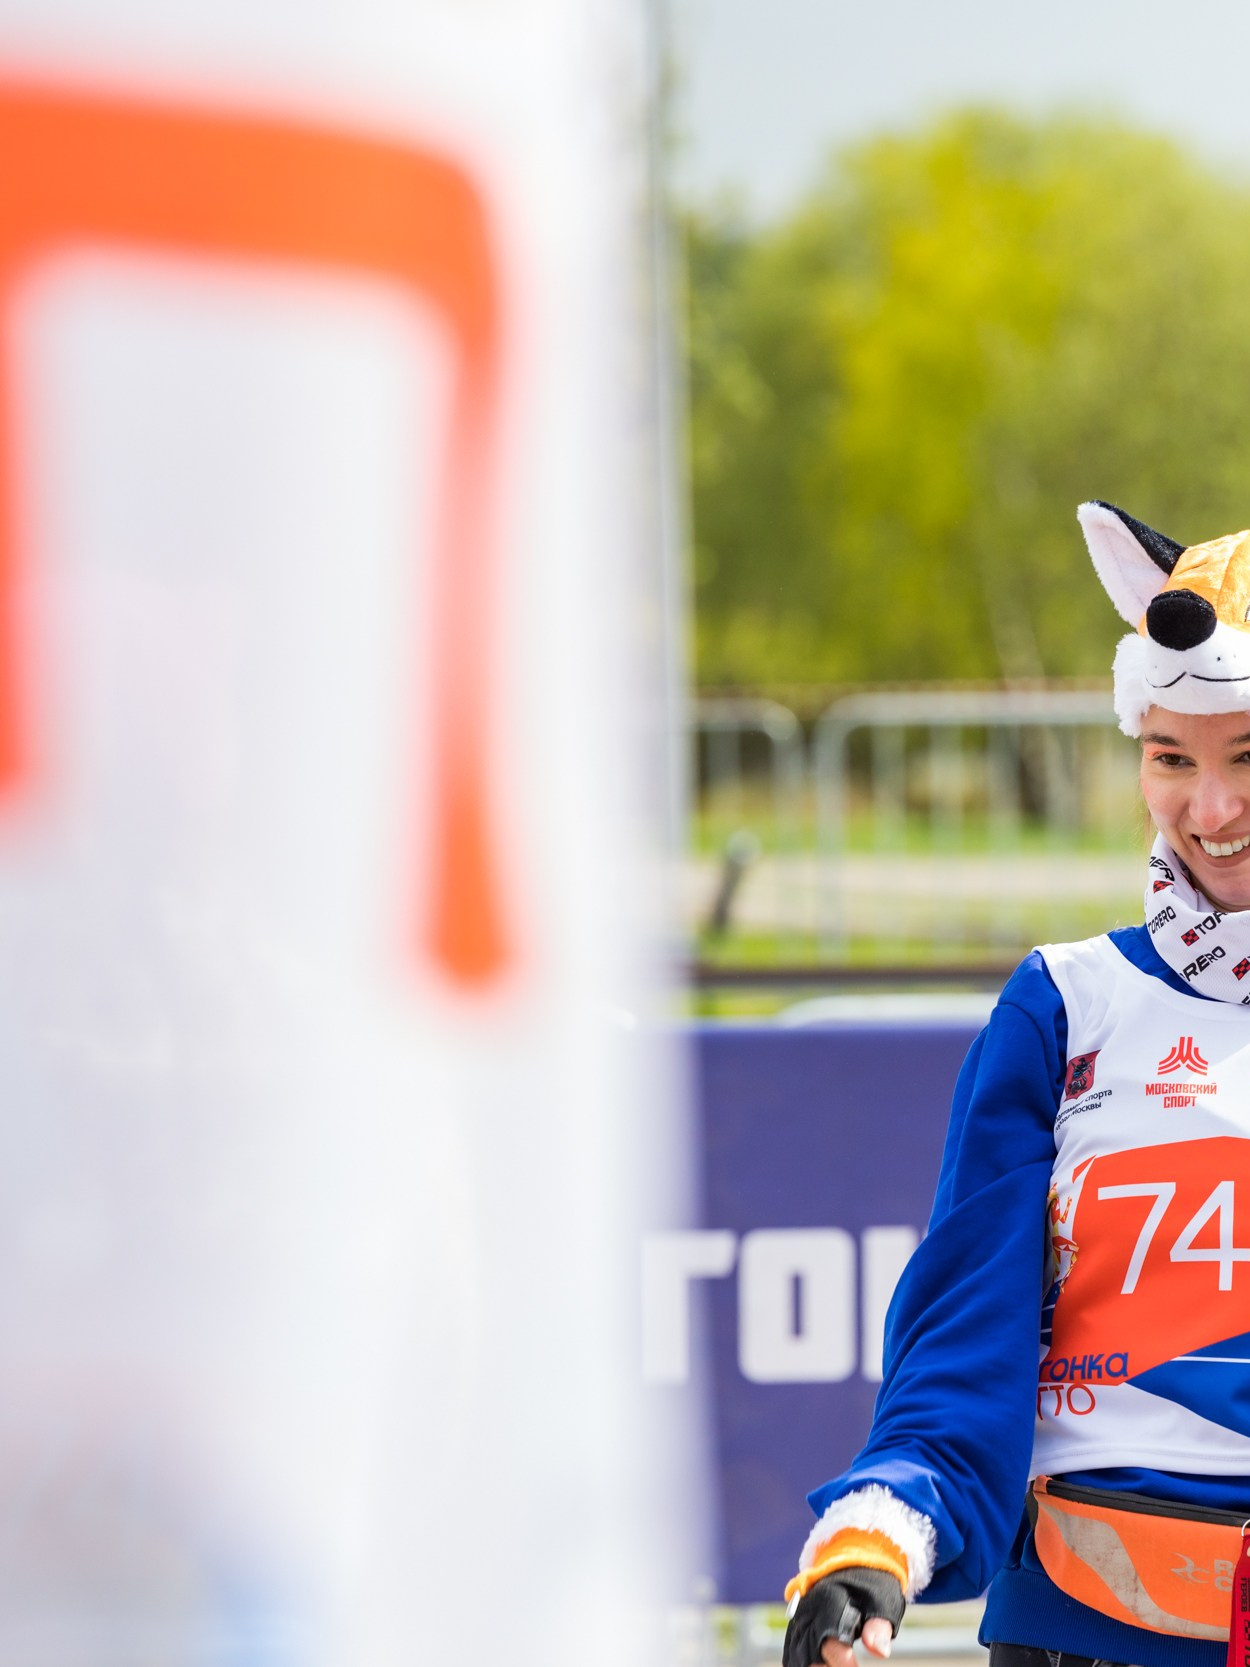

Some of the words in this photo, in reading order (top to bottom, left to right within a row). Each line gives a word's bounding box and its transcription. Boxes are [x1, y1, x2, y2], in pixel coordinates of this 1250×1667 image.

[1179, 945, 1226, 982] RERO
[1145, 1082, 1217, 1096] МОСКОВСКИЙ
[1163, 1096, 1197, 1108] СПОРТ
